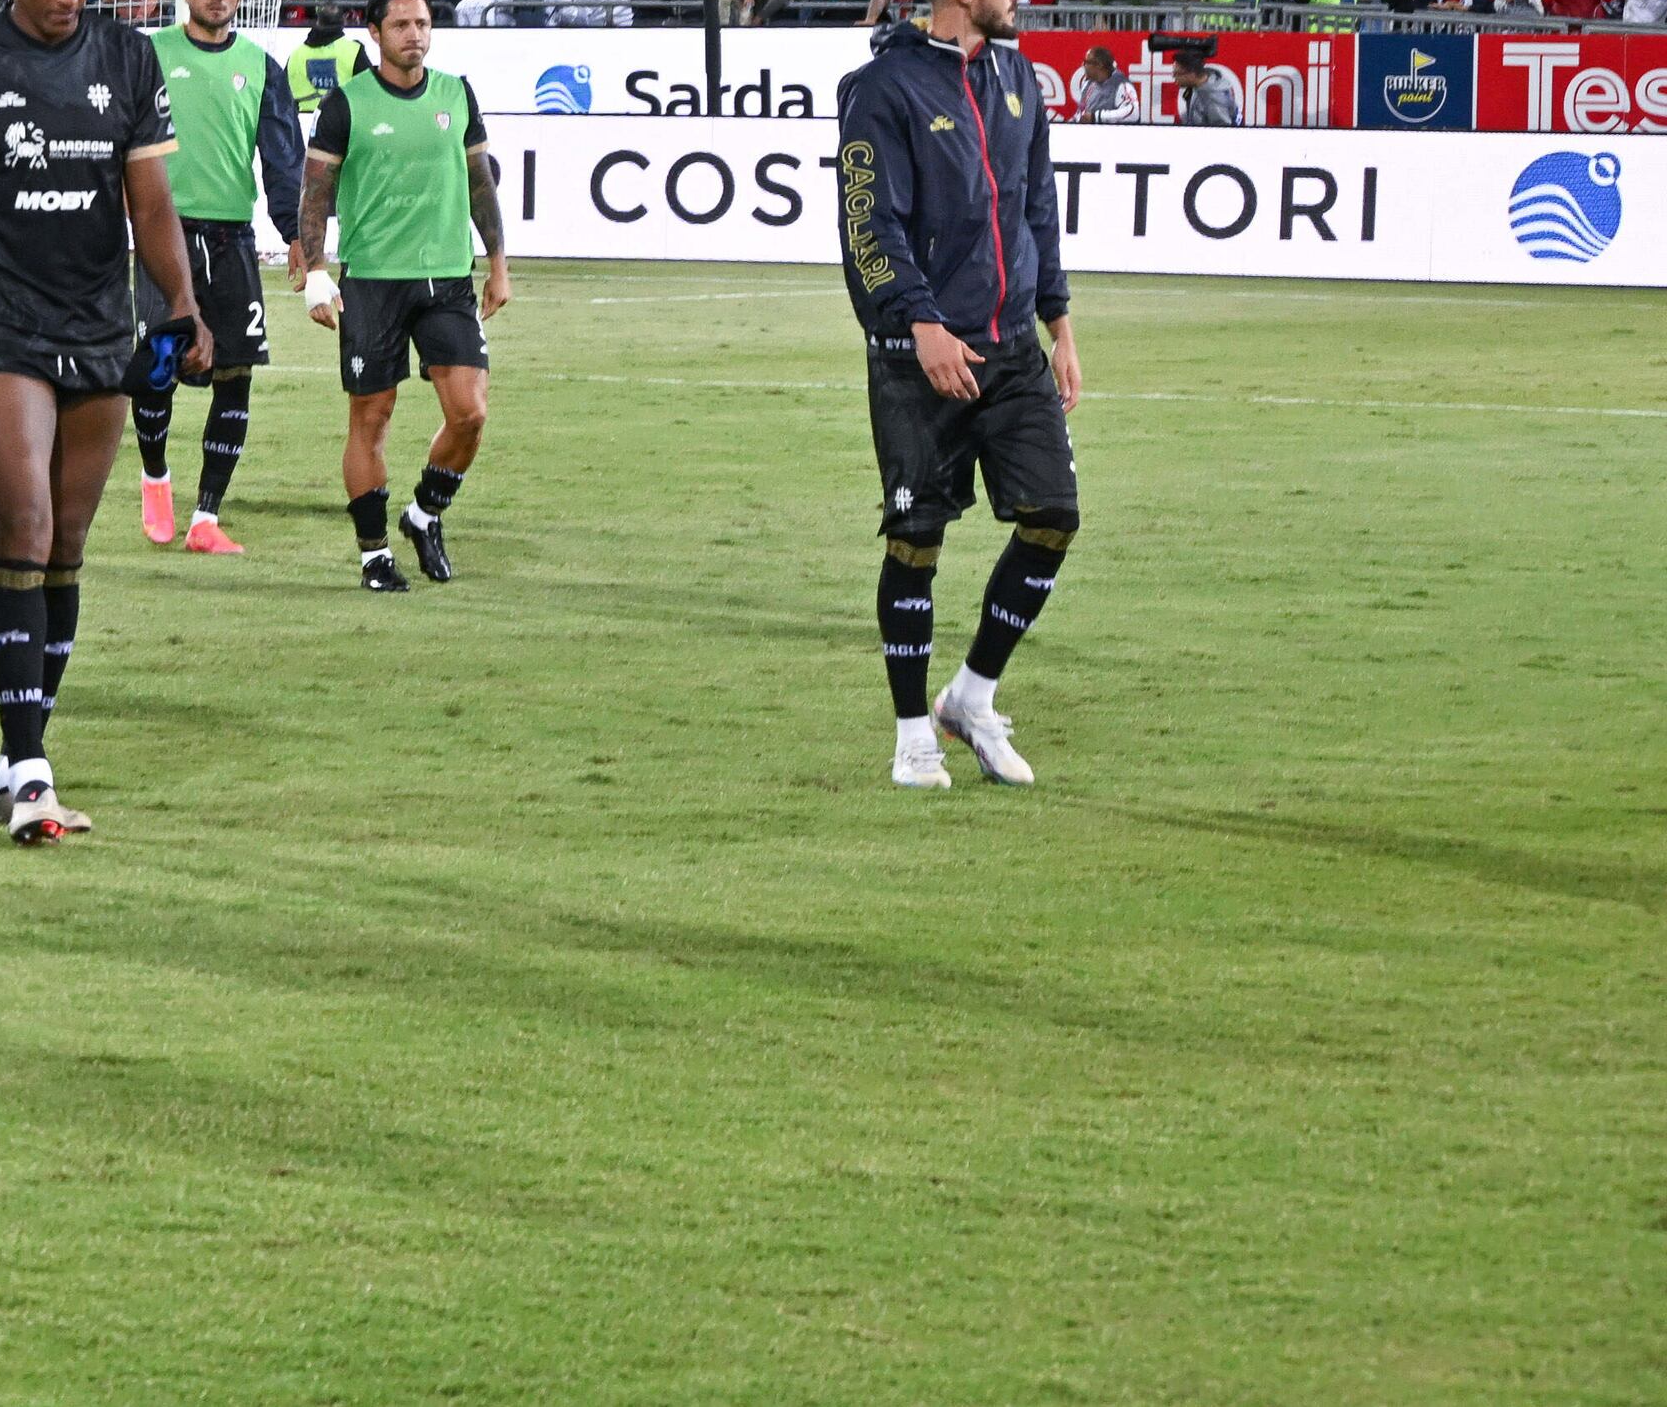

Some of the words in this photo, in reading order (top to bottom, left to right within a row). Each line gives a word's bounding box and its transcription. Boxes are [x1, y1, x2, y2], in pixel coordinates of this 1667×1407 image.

[1398, 89, 1435, 106] point
[48, 140, 114, 153] SARDEGNA
[14, 190, 98, 212] MOBY
[841, 140, 896, 295] CAGLIARI
